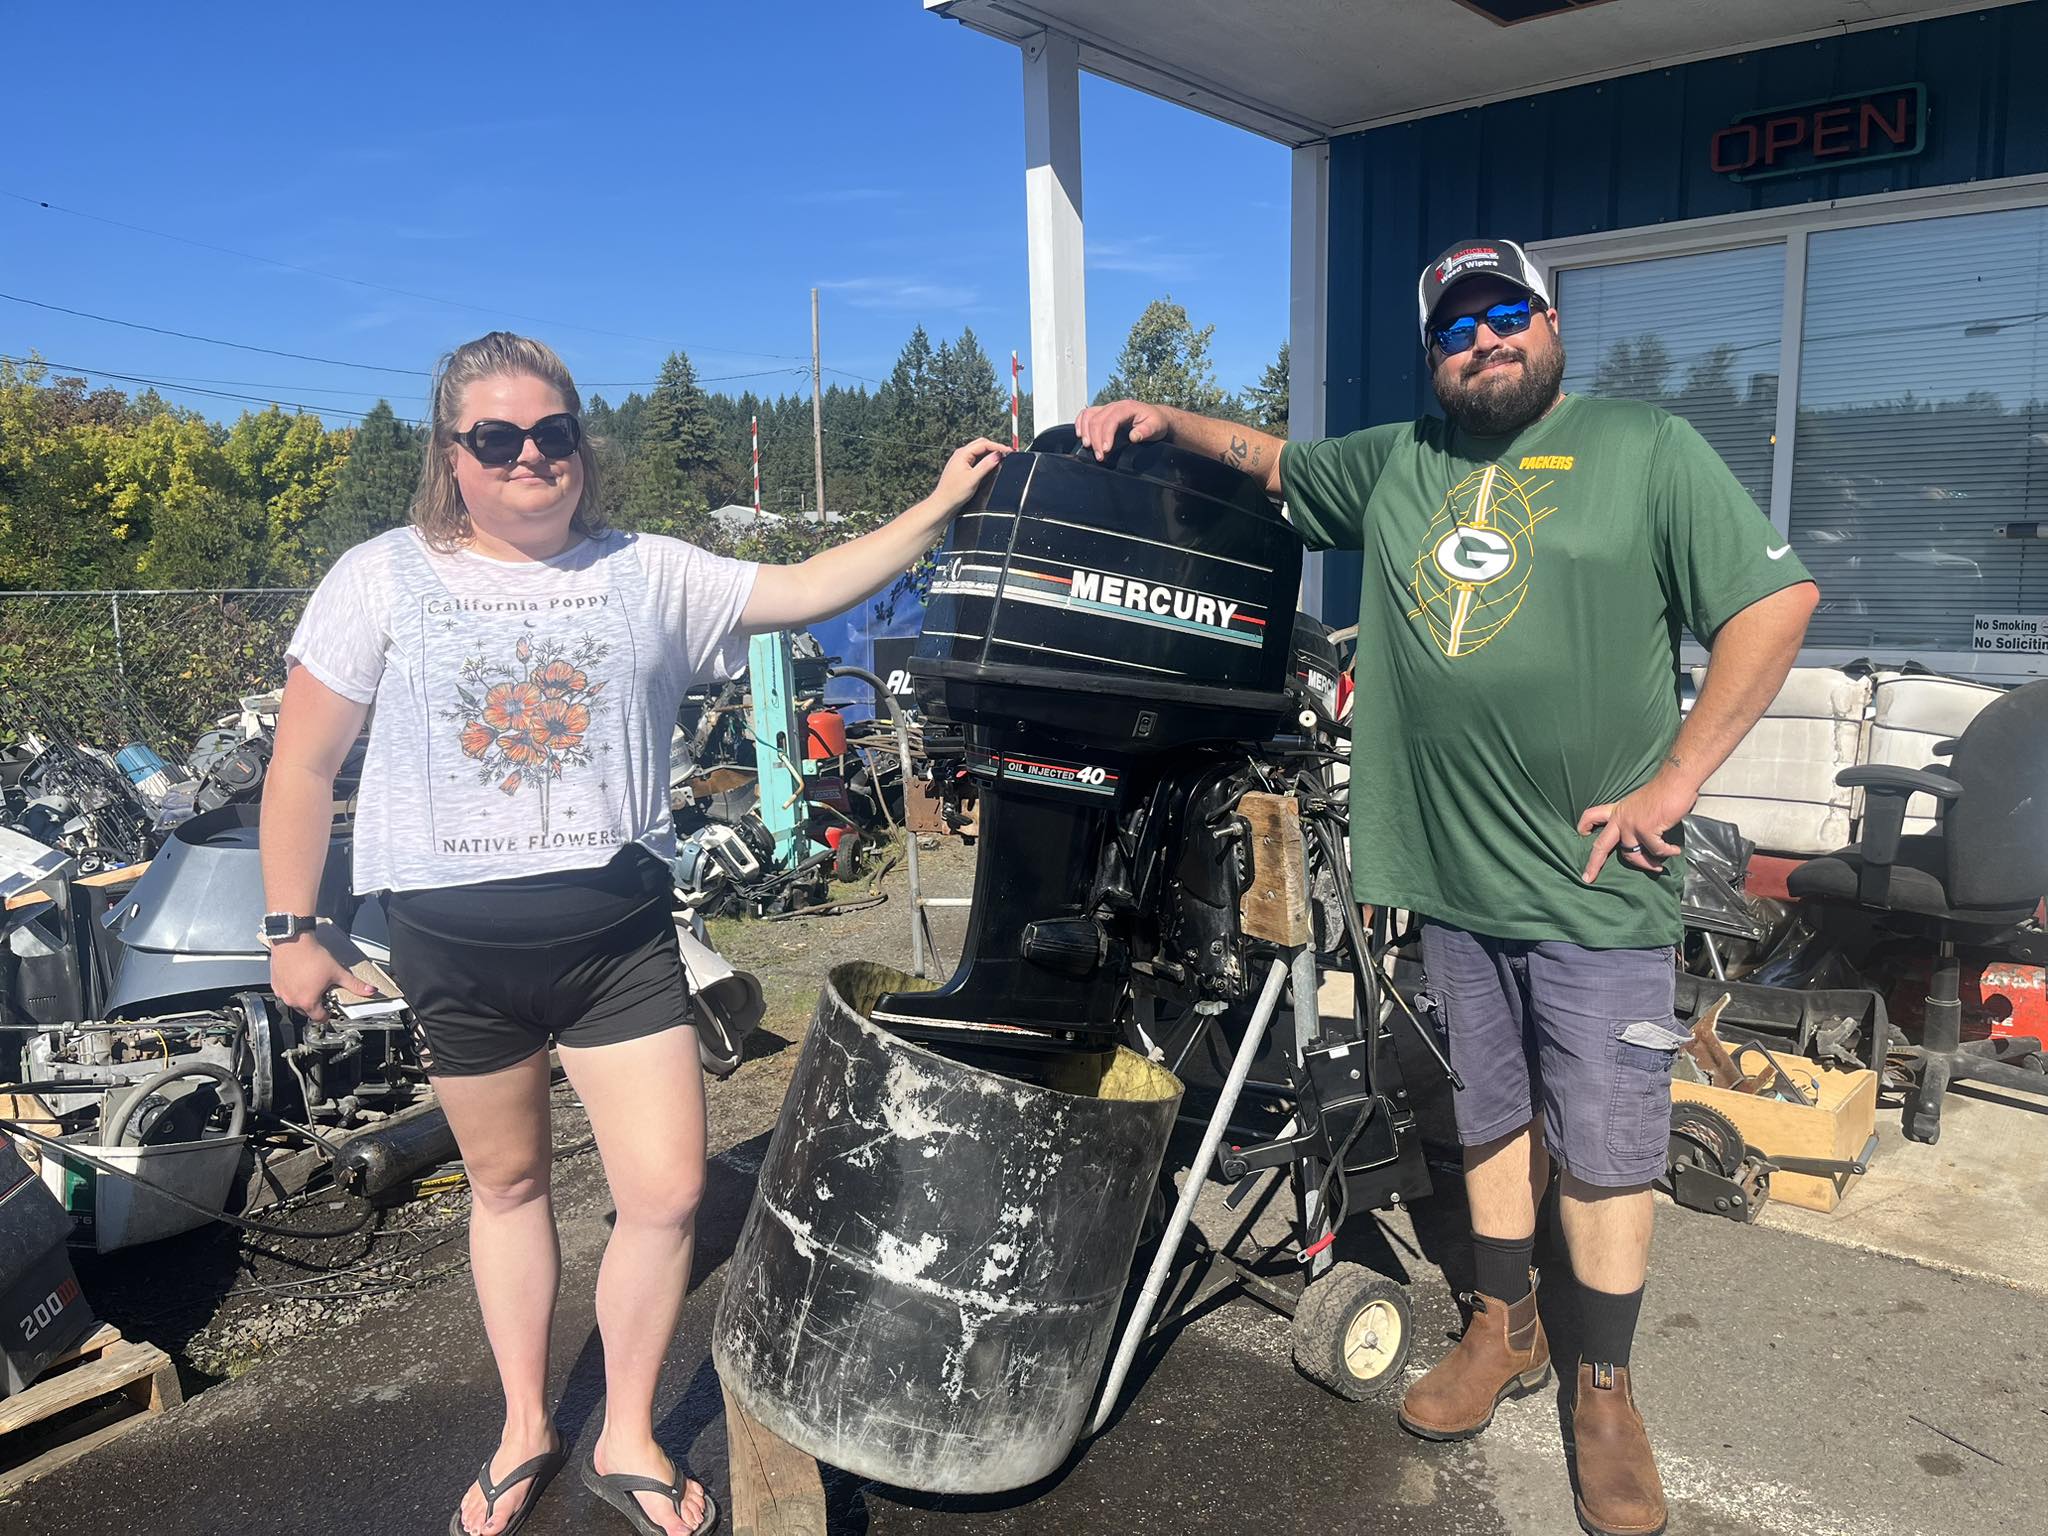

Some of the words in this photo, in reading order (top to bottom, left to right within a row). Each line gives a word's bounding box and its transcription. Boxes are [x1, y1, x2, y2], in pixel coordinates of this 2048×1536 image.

[1711, 98, 1907, 173] OPEN
[1440, 265, 1463, 284] Weed
[1466, 260, 1498, 269] Wipers
[1519, 455, 1576, 471] PACKERS
[1438, 527, 1510, 581] G
[428, 598, 538, 614] California
[549, 594, 609, 609] Poppy
[1071, 570, 1238, 628] MERCURY
[1975, 619, 1989, 630] No
[1992, 619, 2037, 633] Smoking
[1974, 637, 1992, 648] No
[1996, 637, 2048, 650] Solicitin
[1308, 669, 1334, 697] MERC
[1008, 762, 1024, 773] OIL
[1028, 765, 1075, 781] INJECTED
[1076, 766, 1106, 785] 40
[443, 837, 518, 853] NATIVE
[528, 829, 617, 849] FLOWERS
[19, 1291, 64, 1341] 200
